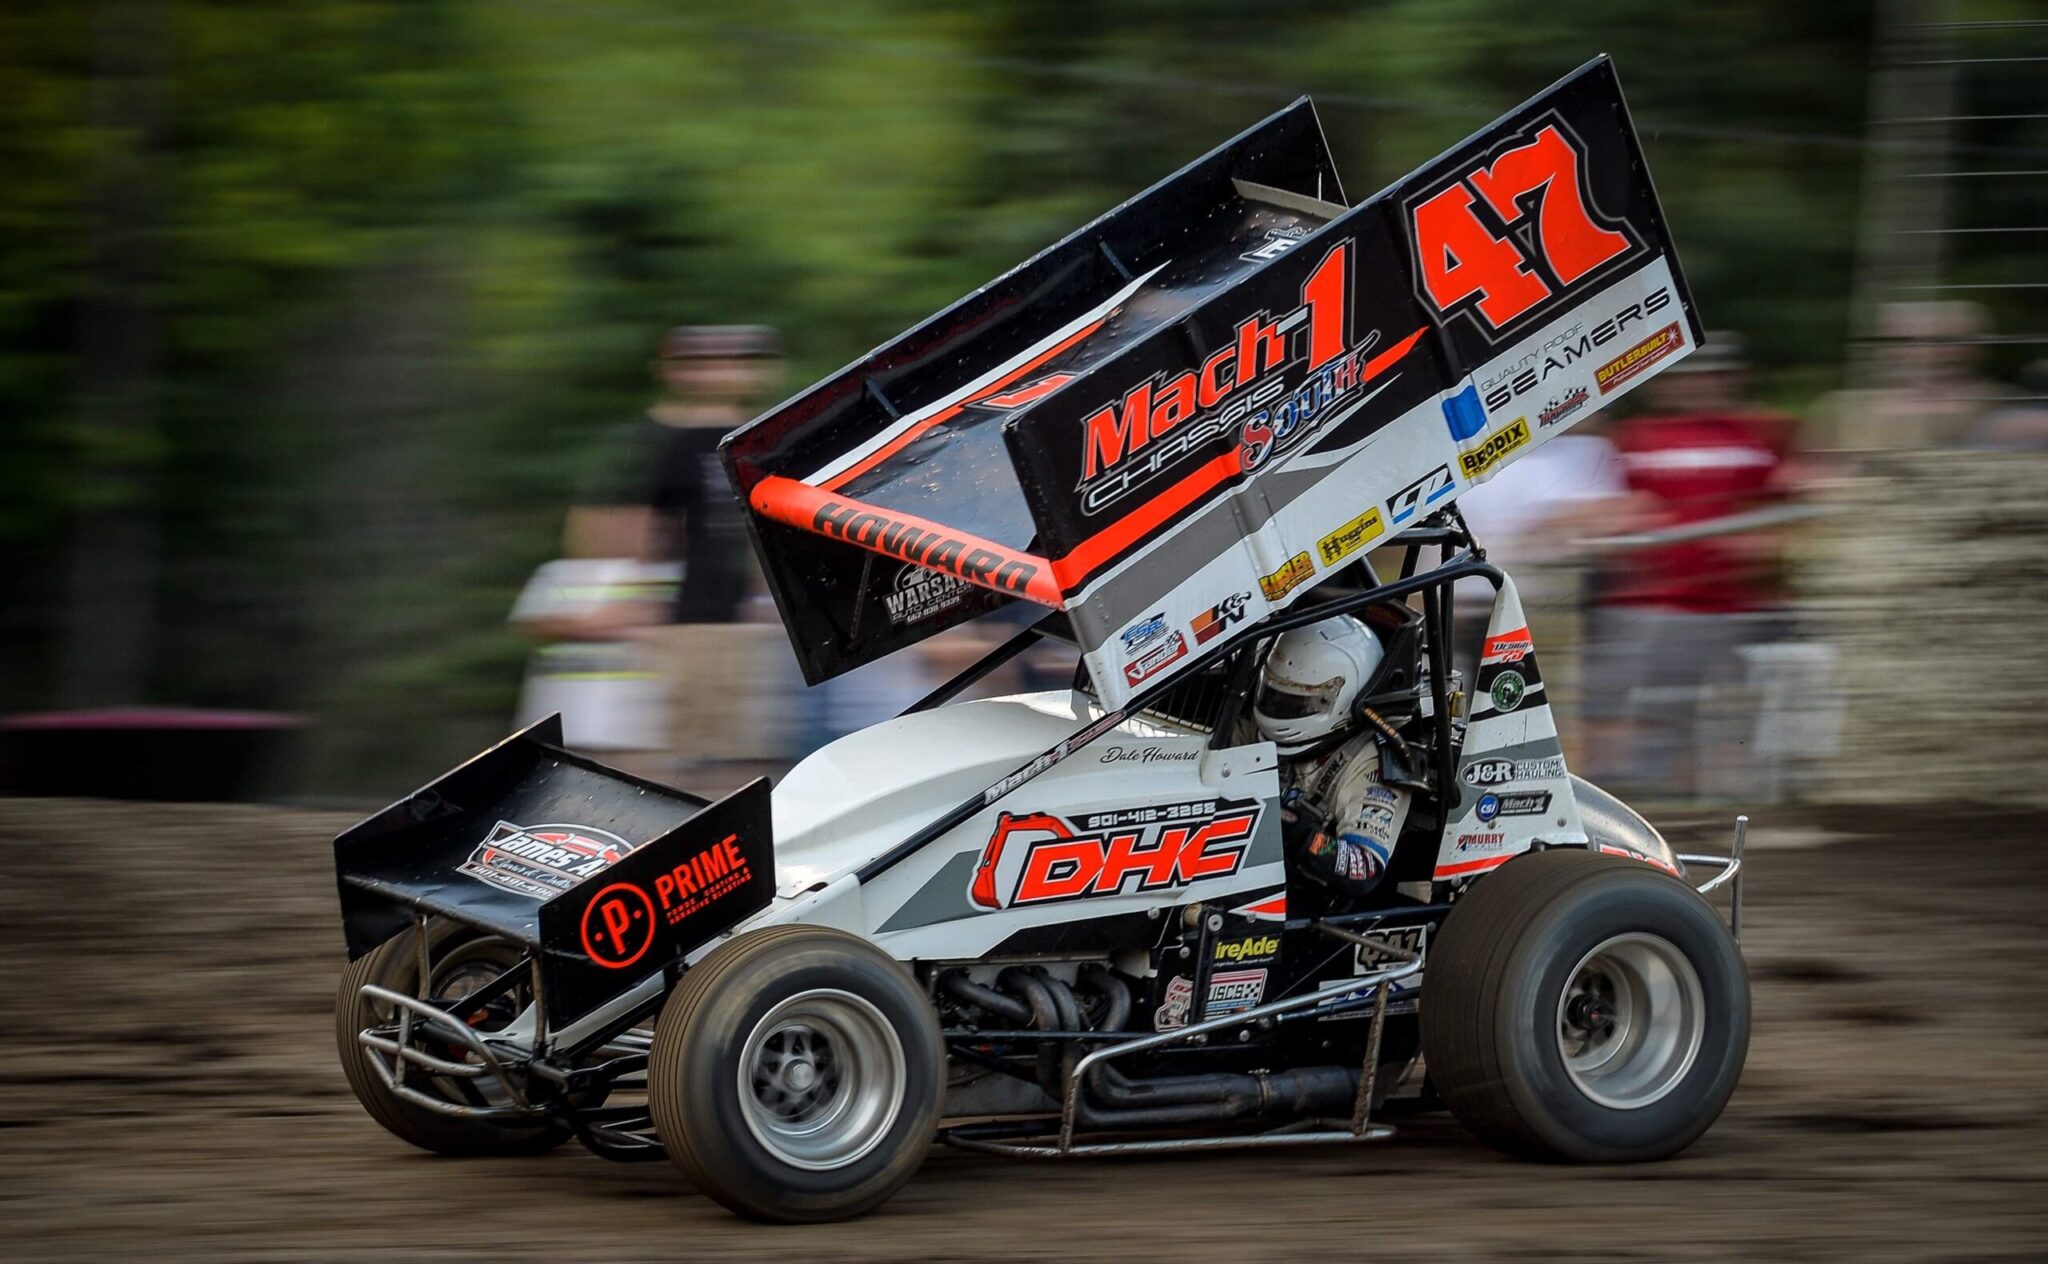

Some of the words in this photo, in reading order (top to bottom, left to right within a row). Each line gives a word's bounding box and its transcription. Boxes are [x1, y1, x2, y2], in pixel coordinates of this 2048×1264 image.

[1411, 123, 1632, 330] 47
[1480, 345, 1540, 392] QUALITY
[1542, 322, 1584, 354] ROOF
[1485, 286, 1671, 414] SEAMERS
[1597, 331, 1668, 382] BUTLERBUILT
[1088, 375, 1286, 508] CHASSIS
[1463, 422, 1524, 470] BRODIX
[811, 502, 1039, 593] HOWARD
[885, 574, 969, 614] WARSA
[892, 604, 923, 622] AUTO
[1210, 590, 1252, 633] K&N
[1099, 745, 1140, 763] Dale
[1141, 746, 1199, 763] Howard
[1465, 759, 1515, 784] J&R
[1514, 758, 1562, 771] CUSTOM
[1514, 769, 1565, 781] HAULING
[1014, 813, 1254, 906] DHC
[1466, 832, 1505, 845] MURRY
[654, 832, 747, 910] PRIME
[711, 872, 752, 901] BLASTING
[600, 898, 631, 957] P
[1214, 936, 1279, 961] ireAde
